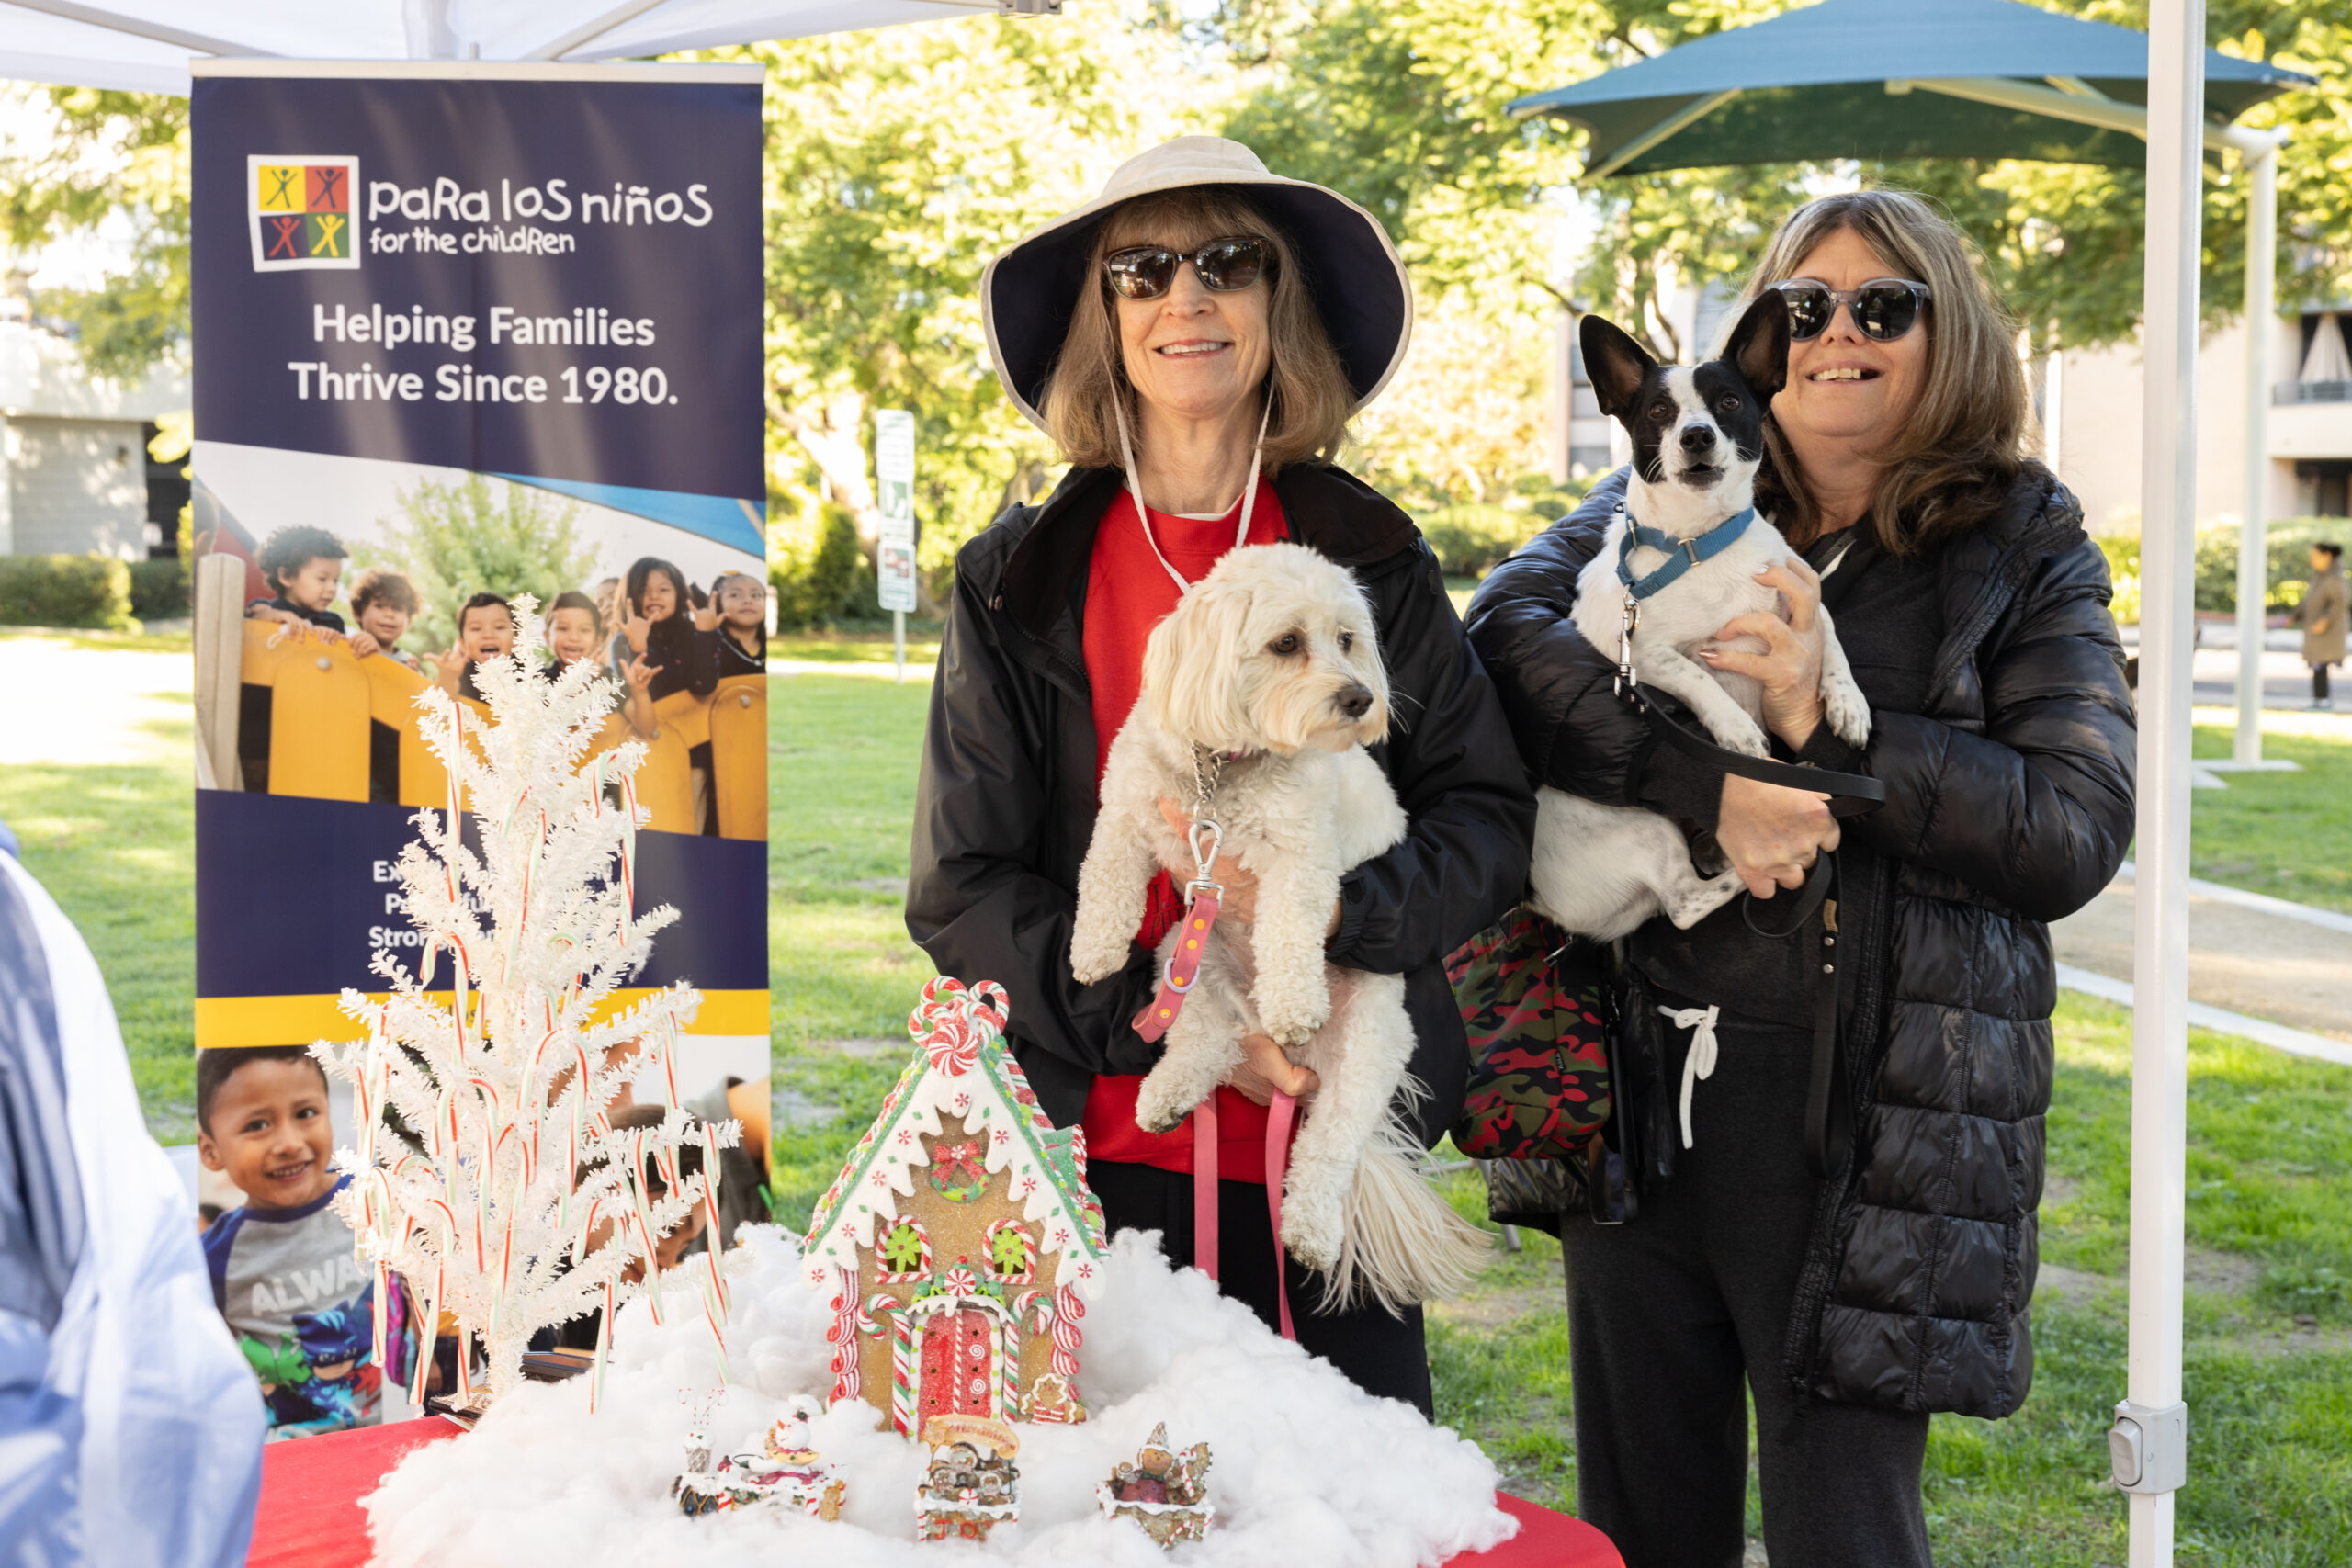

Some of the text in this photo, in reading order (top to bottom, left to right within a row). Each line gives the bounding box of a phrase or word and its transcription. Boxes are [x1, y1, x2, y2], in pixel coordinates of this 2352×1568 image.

[368, 227, 411, 254] for
[412, 226, 458, 254] the
[312, 303, 656, 353] Helping Families
[288, 361, 679, 406] Thrive Since 1980.
[251, 1253, 367, 1318] ALWA
